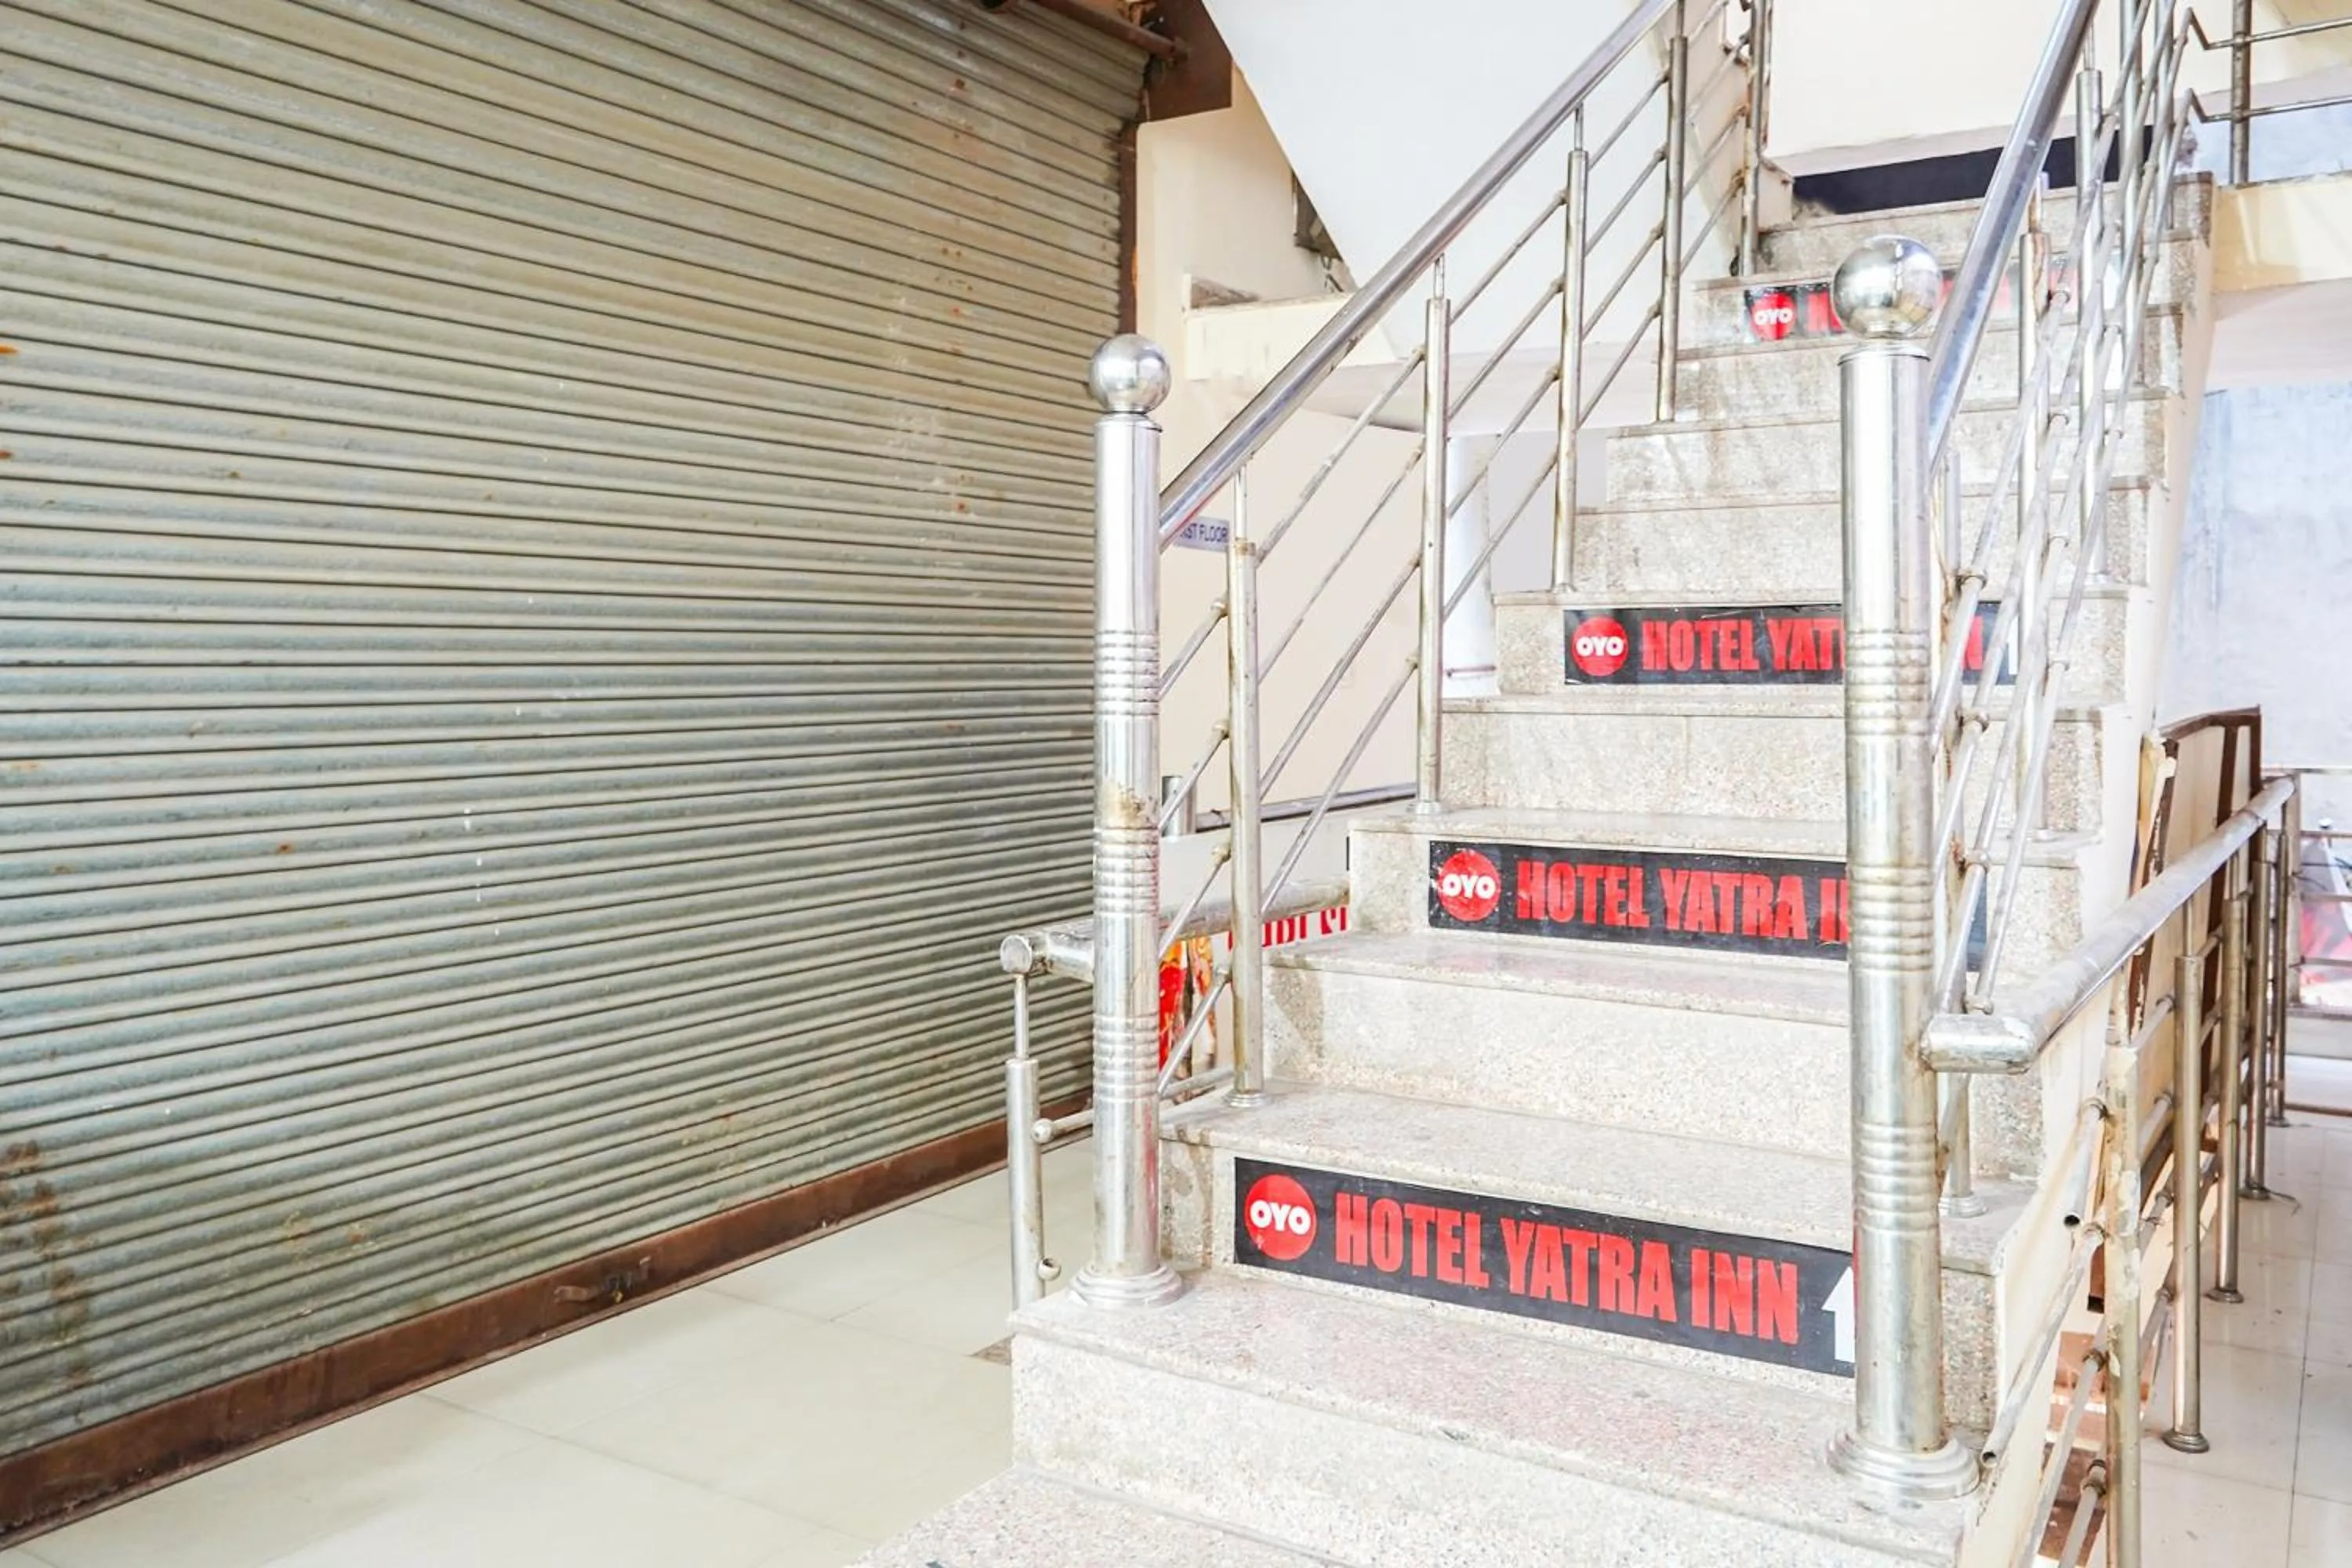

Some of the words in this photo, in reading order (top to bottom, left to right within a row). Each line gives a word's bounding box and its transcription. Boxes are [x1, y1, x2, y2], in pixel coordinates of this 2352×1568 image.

[1754, 307, 1793, 325] OYO
[1199, 524, 1229, 543] FLOOR
[1575, 636, 1624, 657] OYO
[1641, 618, 1760, 671] HOTEL
[1766, 618, 1845, 671] YAT
[1443, 873, 1497, 900] OYO
[1515, 859, 1650, 928] HOTEL
[1659, 867, 1809, 940] YATRA
[1250, 1200, 1312, 1236] OYO
[1335, 1191, 1490, 1288] HOTEL
[1500, 1218, 1677, 1322] YATRA
[1690, 1248, 1798, 1344] INN
